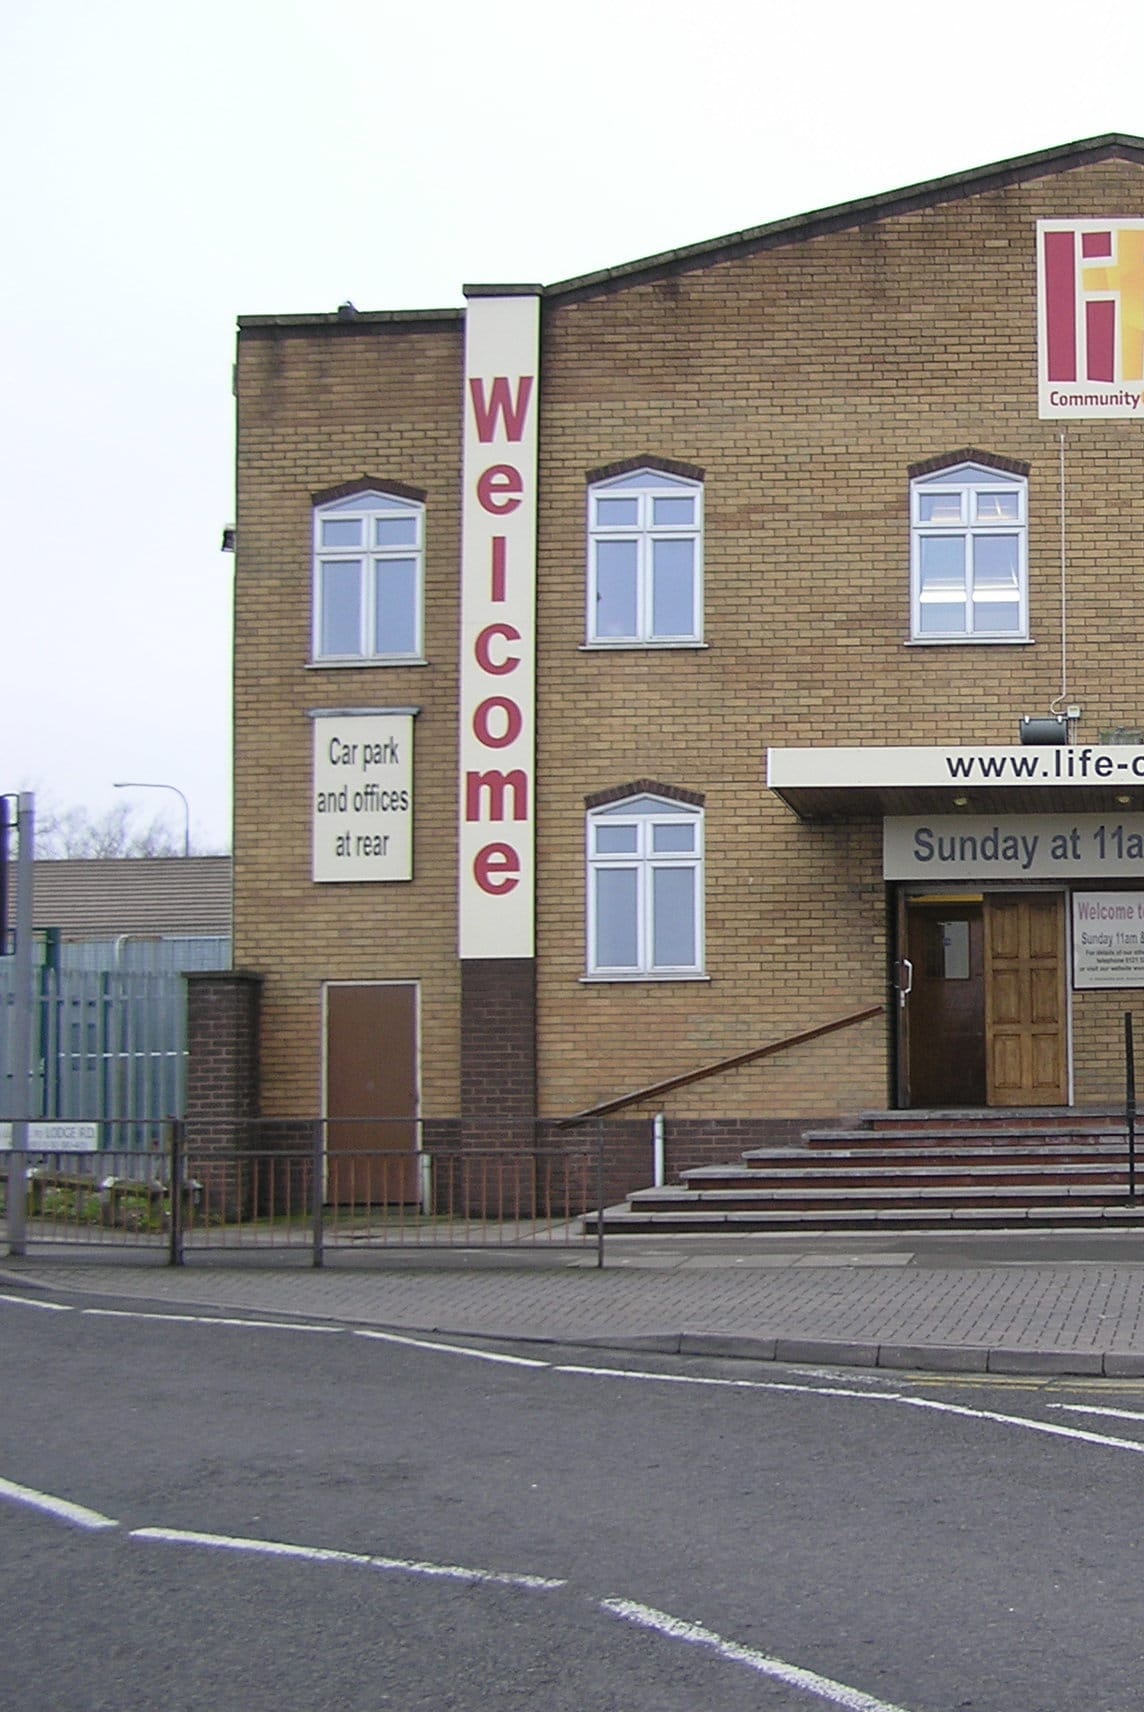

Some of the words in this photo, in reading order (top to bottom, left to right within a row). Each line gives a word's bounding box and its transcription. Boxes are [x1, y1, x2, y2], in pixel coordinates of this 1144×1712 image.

[464, 375, 534, 896] Welcome
[329, 736, 358, 766] Car
[363, 735, 399, 772] park
[317, 784, 348, 813] and
[353, 783, 409, 812] offices
[335, 830, 351, 857] at
[356, 833, 390, 857] rear
[913, 826, 1040, 870] Sunday
[1050, 827, 1082, 860] at
[1078, 902, 1134, 920] Welcome
[1081, 932, 1113, 947] Sunday
[1115, 932, 1138, 944] 11am
